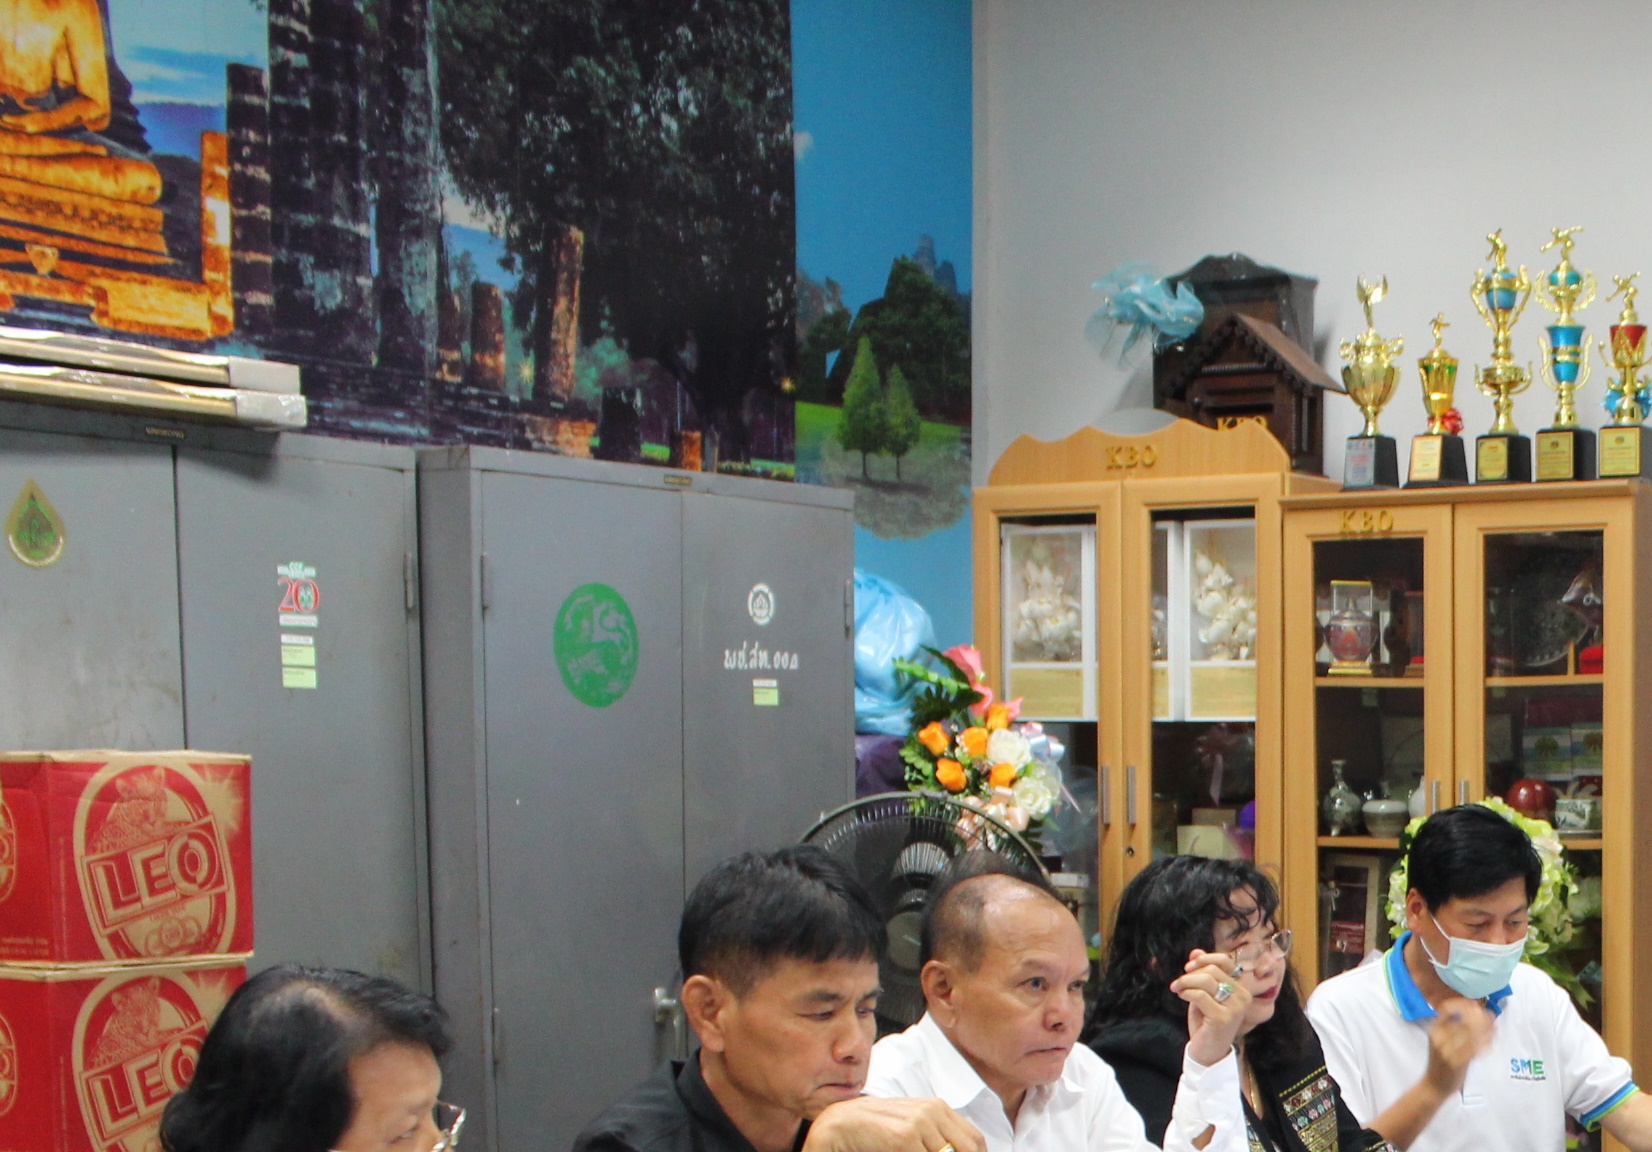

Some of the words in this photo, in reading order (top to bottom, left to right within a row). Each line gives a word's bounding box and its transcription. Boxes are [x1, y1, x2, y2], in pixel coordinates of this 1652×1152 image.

[1105, 445, 1158, 469] KBO
[1339, 509, 1395, 533] KBO
[278, 576, 320, 613] 20
[90, 829, 219, 926] LEO
[1511, 1058, 1544, 1074] SME
[88, 1035, 205, 1142] LEO
